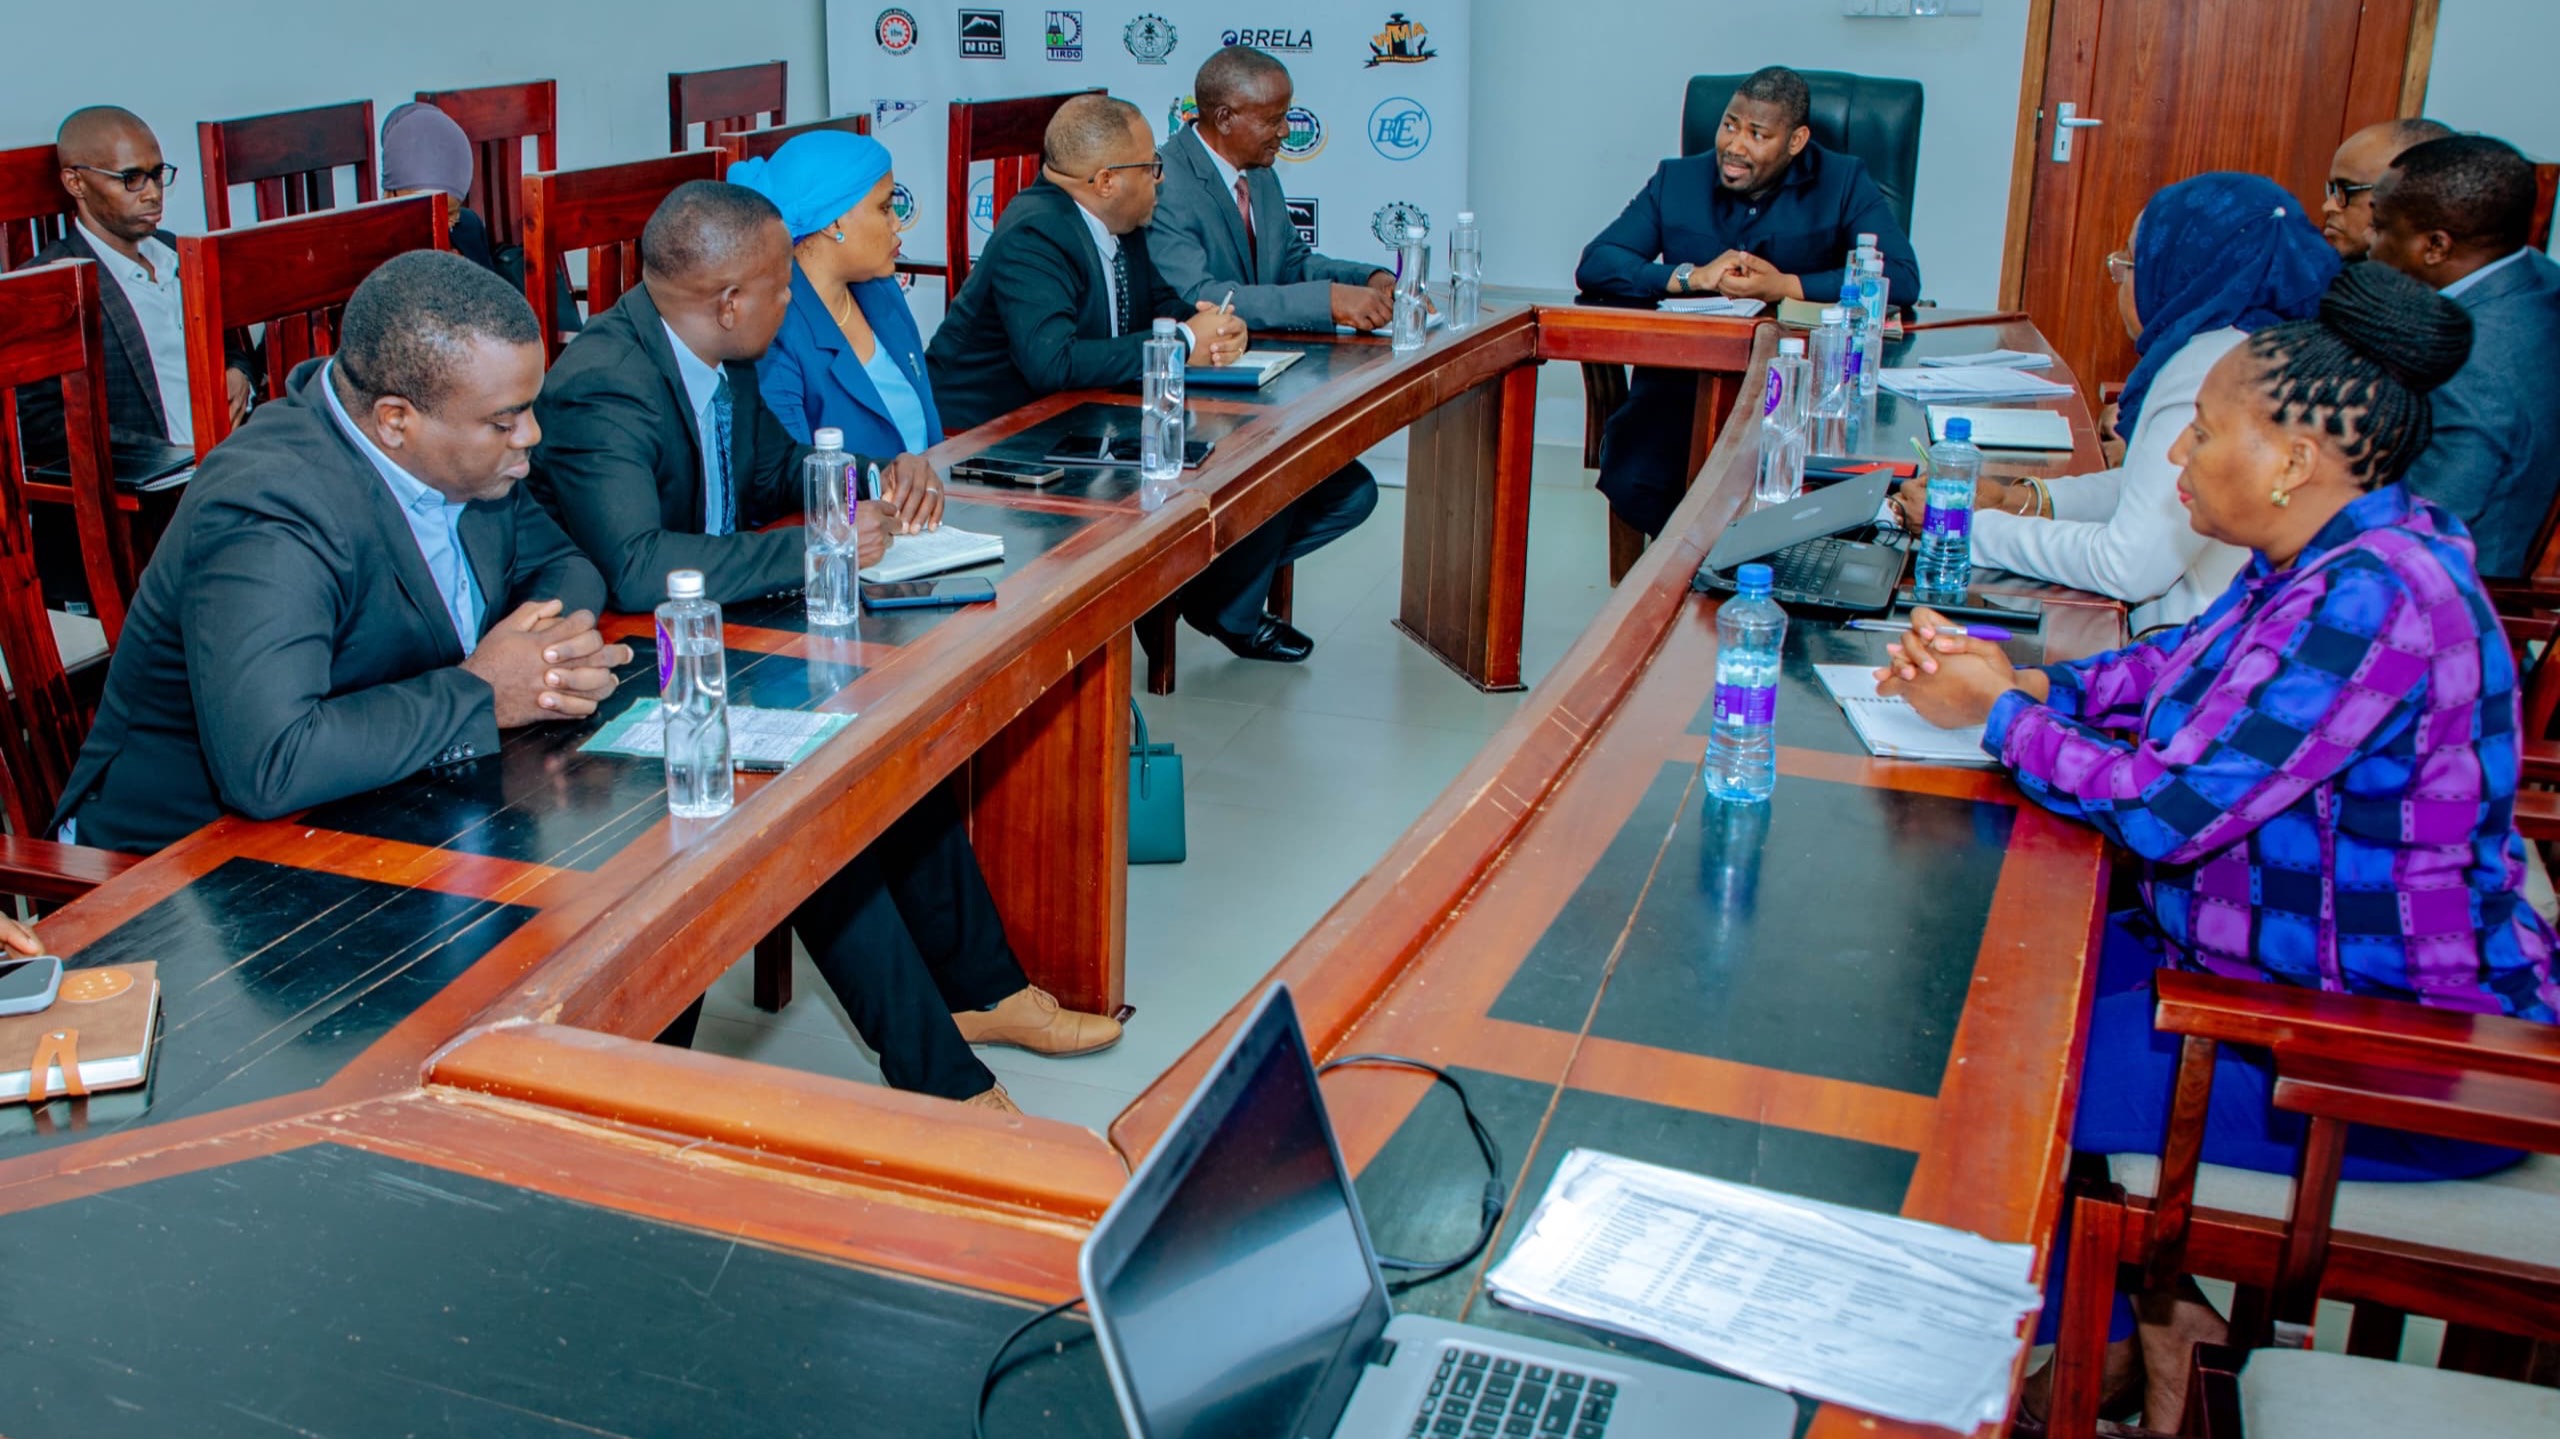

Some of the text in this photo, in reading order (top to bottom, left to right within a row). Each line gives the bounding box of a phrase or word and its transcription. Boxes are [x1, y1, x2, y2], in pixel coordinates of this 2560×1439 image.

[1240, 28, 1312, 47] BRELA
[1373, 21, 1428, 47] WMA
[965, 41, 999, 53] NDC
[1049, 48, 1080, 58] TIRDO
